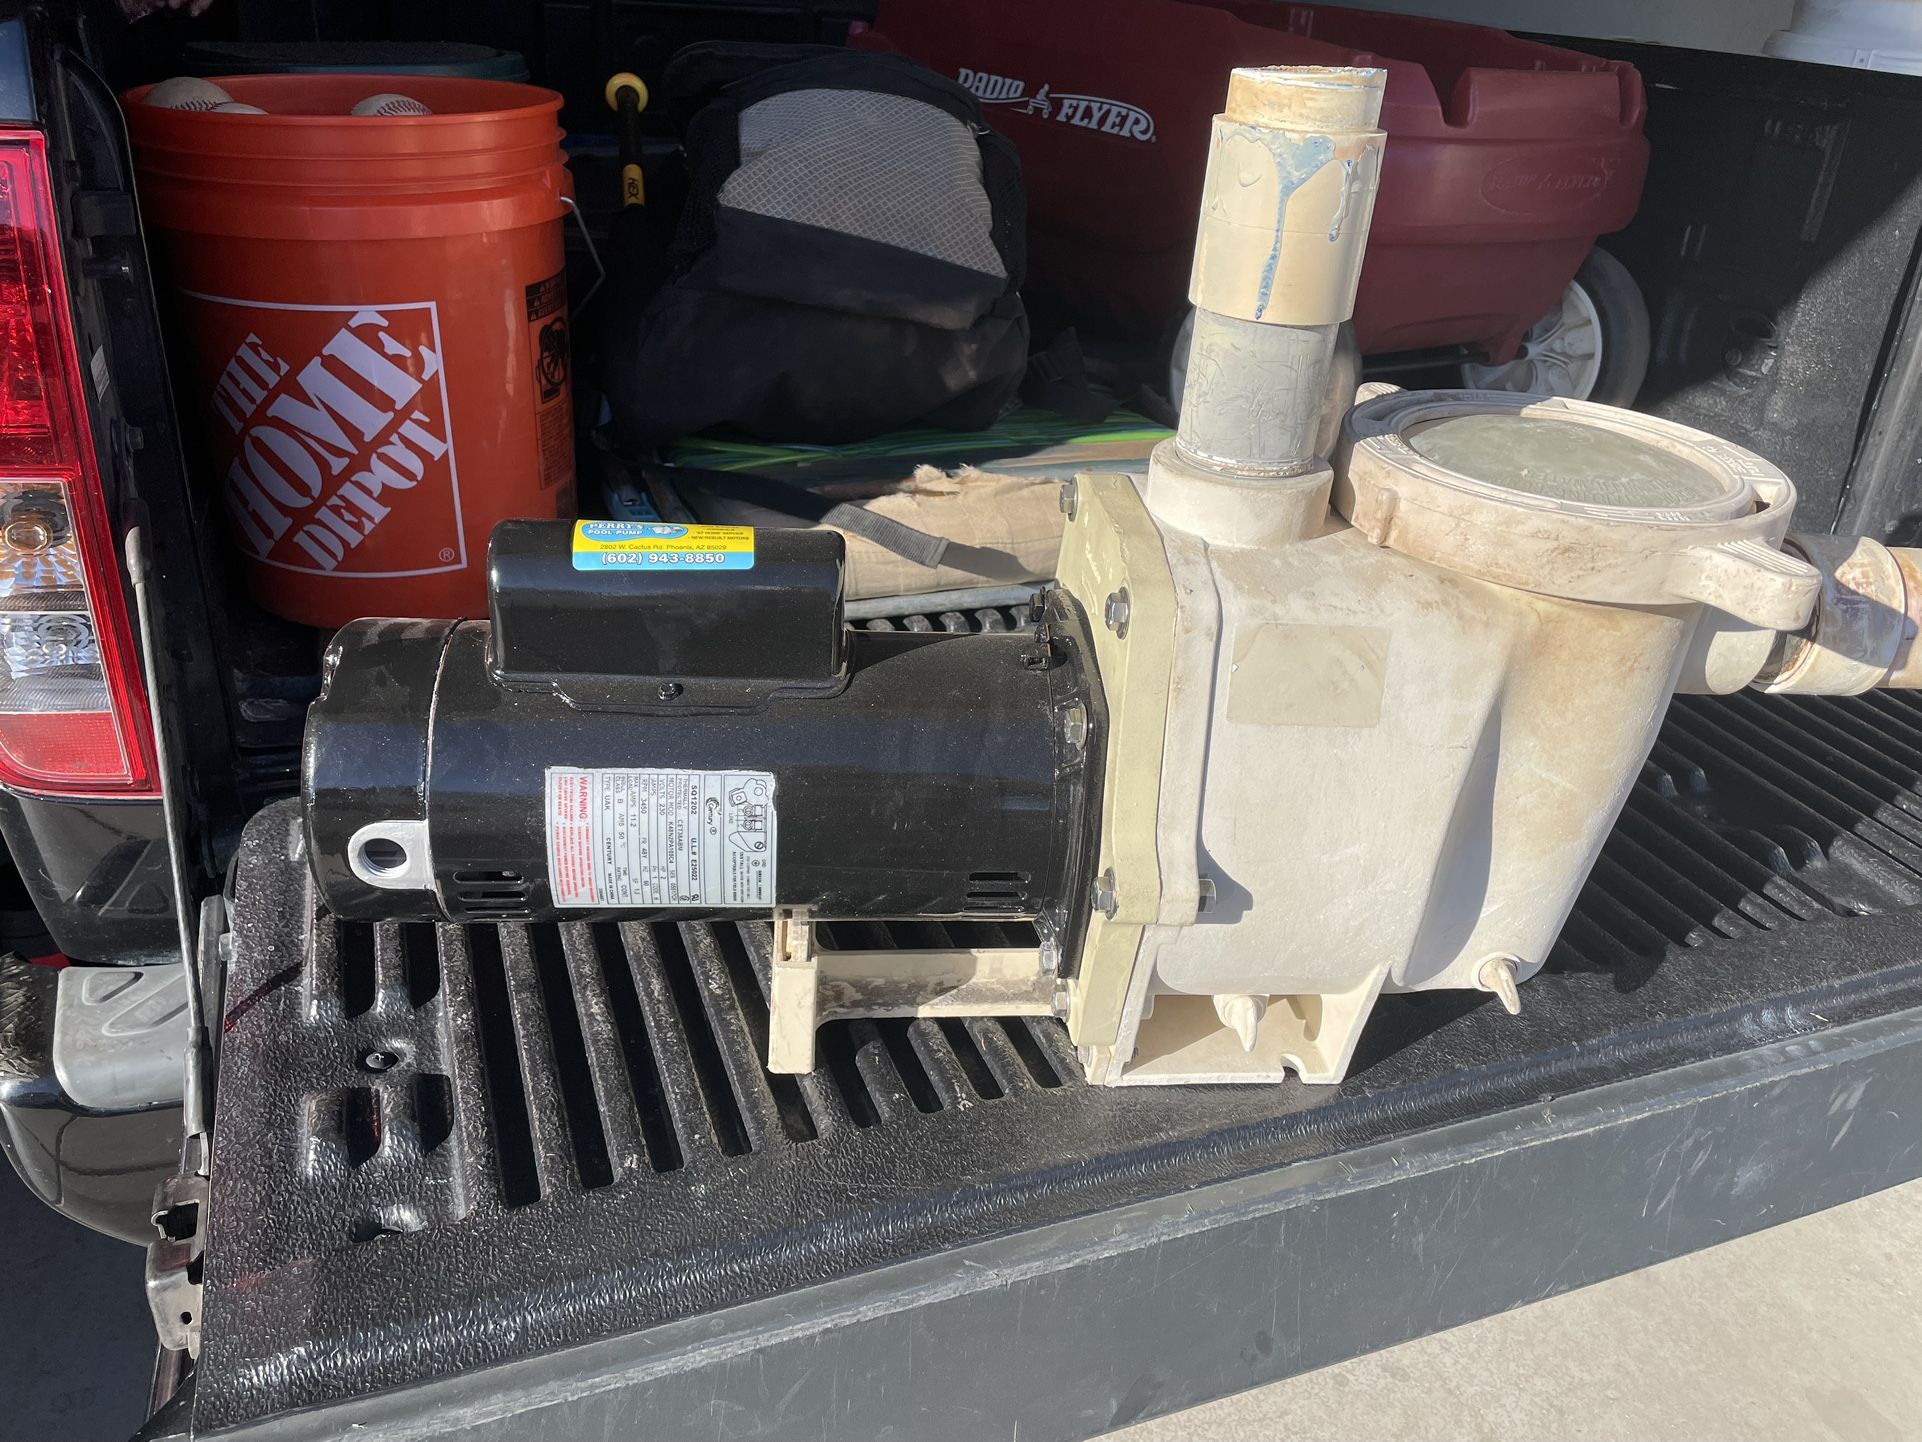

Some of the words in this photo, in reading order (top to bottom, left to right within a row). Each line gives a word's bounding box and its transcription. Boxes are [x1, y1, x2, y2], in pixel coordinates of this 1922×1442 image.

[957, 67, 1026, 100] RADIO
[1055, 98, 1154, 142] FLYER
[211, 332, 291, 437] THE
[226, 309, 440, 560] HOME
[292, 409, 450, 572] DEPOT
[602, 553, 643, 565] (602)
[648, 553, 725, 563] 943-8850
[618, 831, 624, 839] 50
